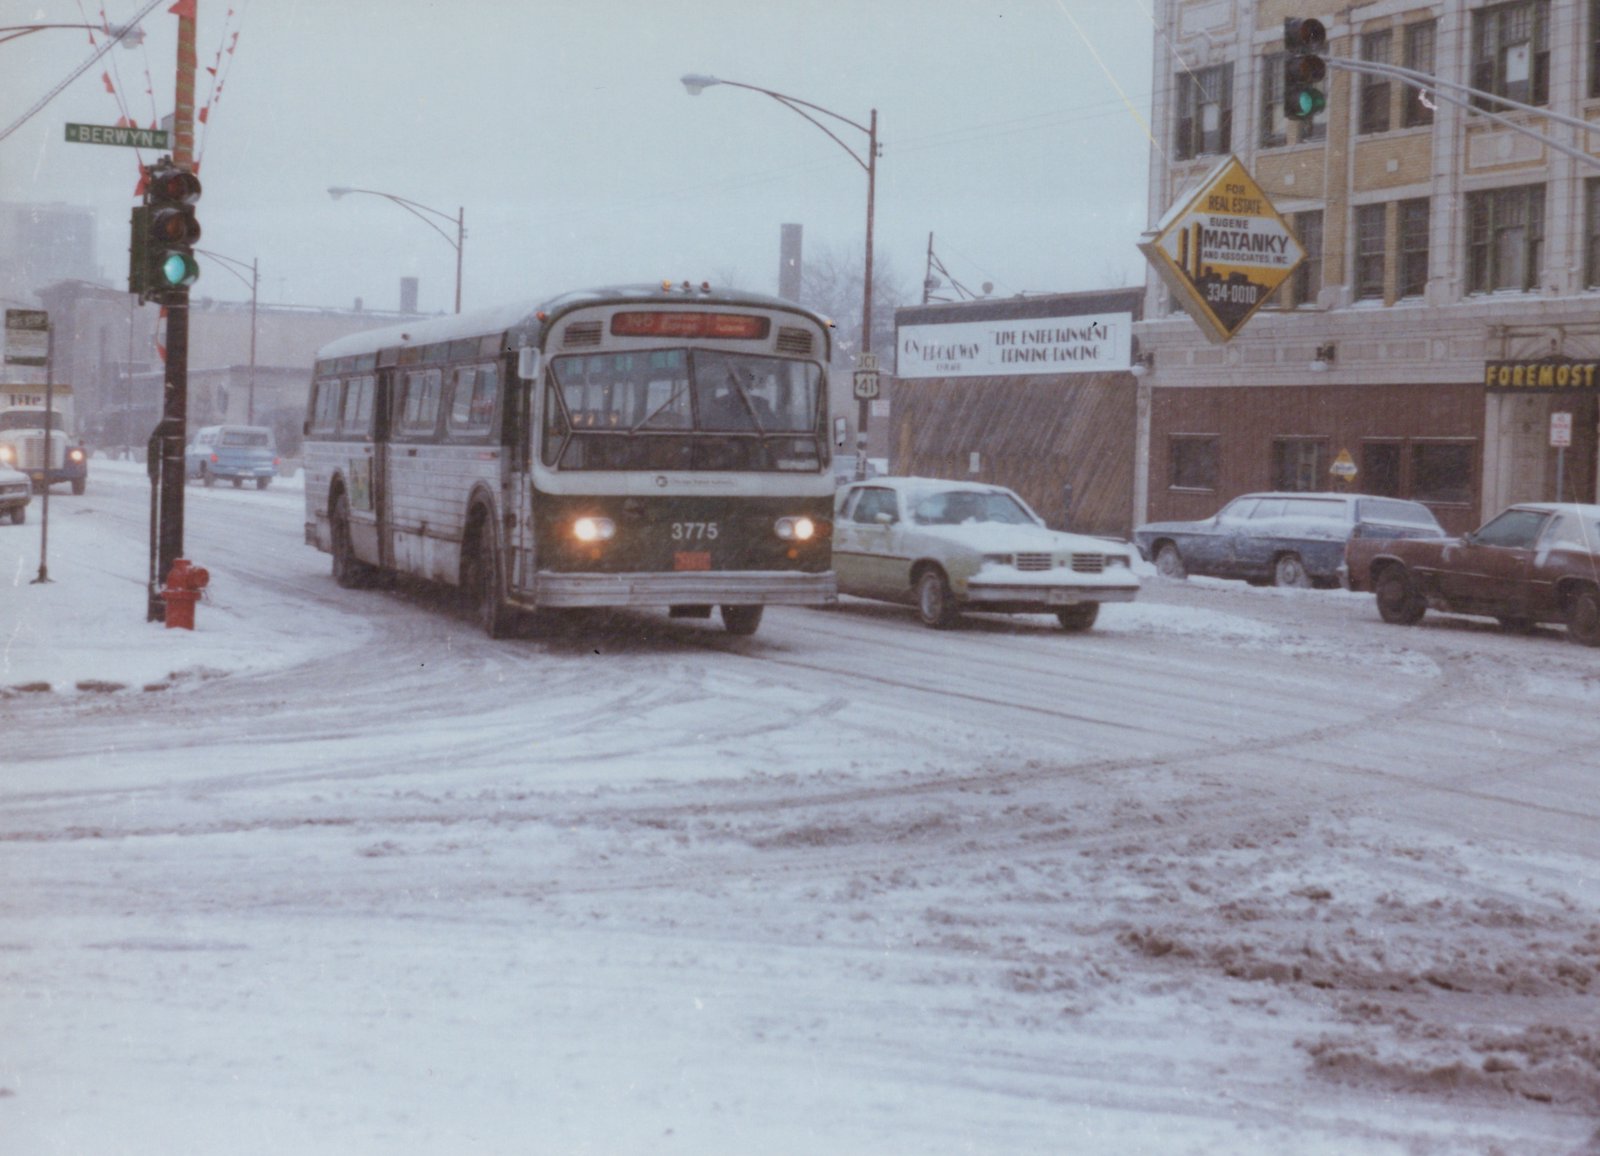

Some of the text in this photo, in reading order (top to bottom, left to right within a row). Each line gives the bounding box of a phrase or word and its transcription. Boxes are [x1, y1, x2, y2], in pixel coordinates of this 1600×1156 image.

[79, 126, 153, 147] BERWYN
[1226, 184, 1246, 194] FOR
[1208, 195, 1262, 215] REAL ESTATE
[1210, 217, 1249, 229] EUGENE
[1203, 229, 1289, 254] MATANKY
[1203, 250, 1219, 260] AND
[1207, 282, 1257, 305] 334-0010
[996, 324, 1108, 346] LIVE ENTERTAINMENT
[922, 343, 980, 361] BROADWAY
[1486, 363, 1597, 387] FOREMOST
[858, 377, 874, 394] 41
[671, 522, 718, 540] 3775
